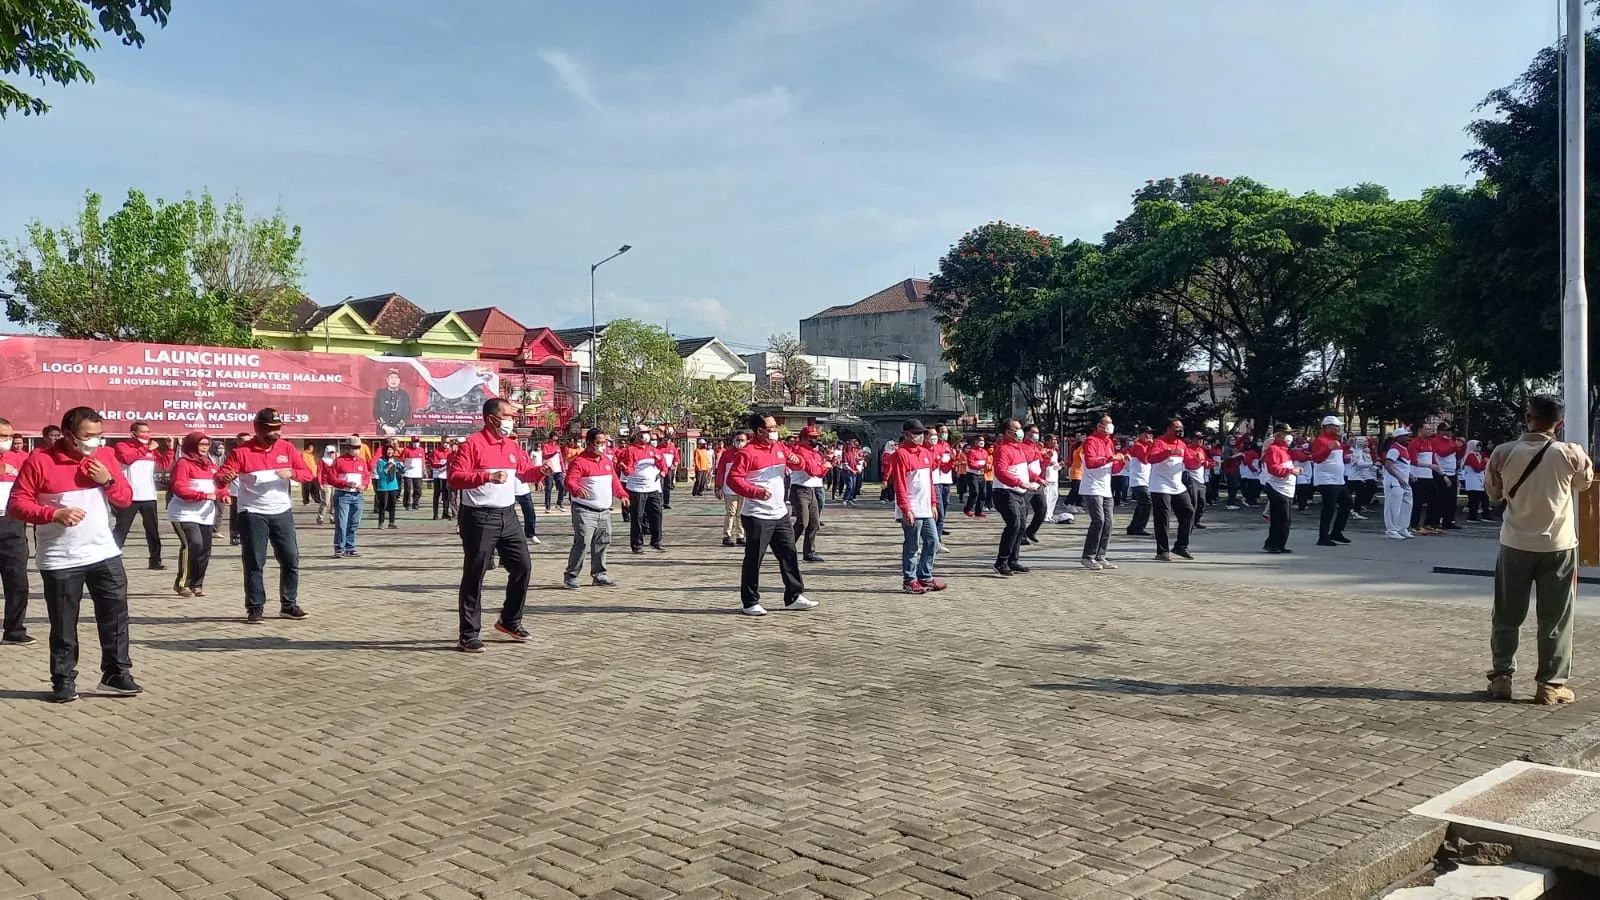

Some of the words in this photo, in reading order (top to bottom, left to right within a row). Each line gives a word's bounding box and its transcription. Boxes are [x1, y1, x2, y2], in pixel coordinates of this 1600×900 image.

[144, 348, 260, 367] LAUNCHING
[42, 362, 84, 373] LOGO
[88, 364, 123, 375] HARI
[127, 365, 159, 376] JADI
[163, 367, 212, 379] KE-1262
[215, 369, 290, 381] KABUPATEN
[293, 372, 343, 383] MALANG
[108, 377, 121, 385] 28
[123, 378, 178, 386] NOVEMBER
[163, 399, 247, 411] PERINGATAN
[97, 410, 122, 420] ARI
[125, 411, 164, 421] OLAH
[167, 412, 205, 422] RAGA
[208, 412, 257, 422] NASION
